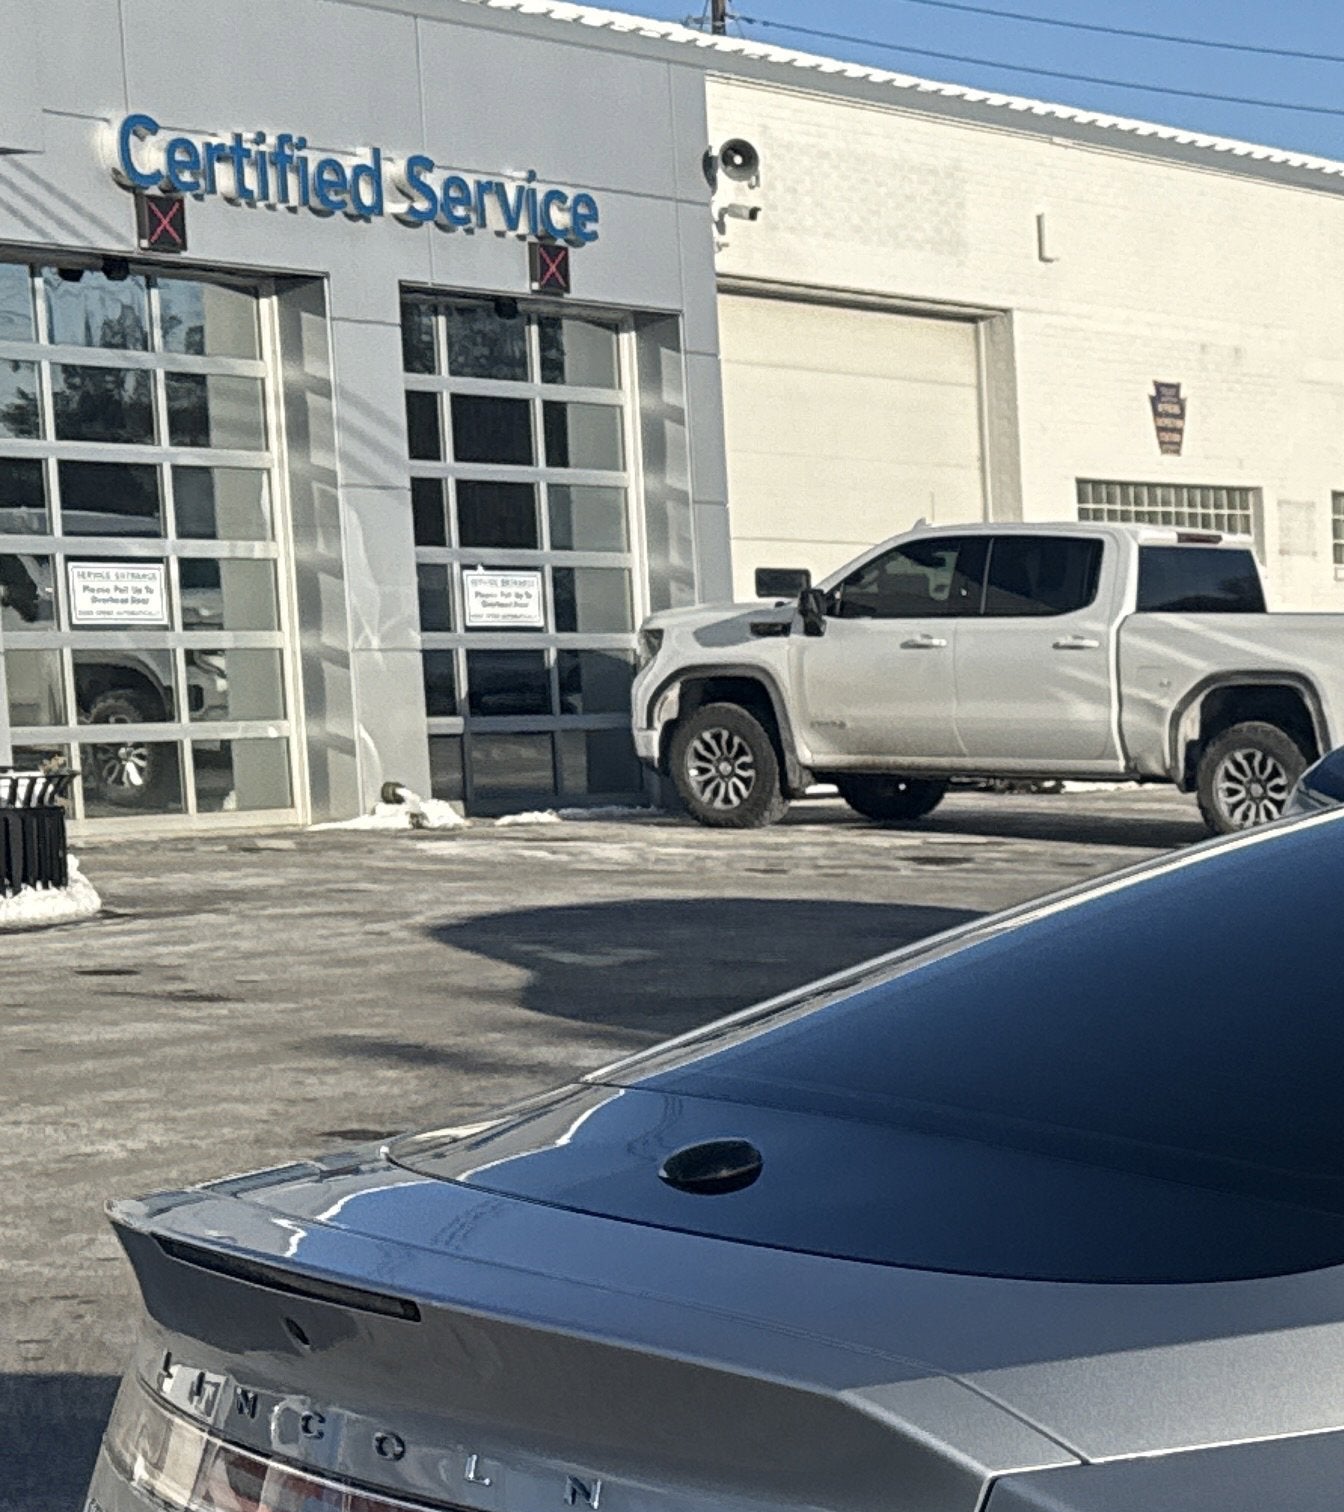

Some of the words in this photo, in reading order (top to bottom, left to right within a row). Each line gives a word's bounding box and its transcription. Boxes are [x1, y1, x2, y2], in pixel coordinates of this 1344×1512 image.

[118, 113, 384, 218] Certified
[404, 154, 600, 243] Service
[158, 1347, 602, 1511] LINCOLN
